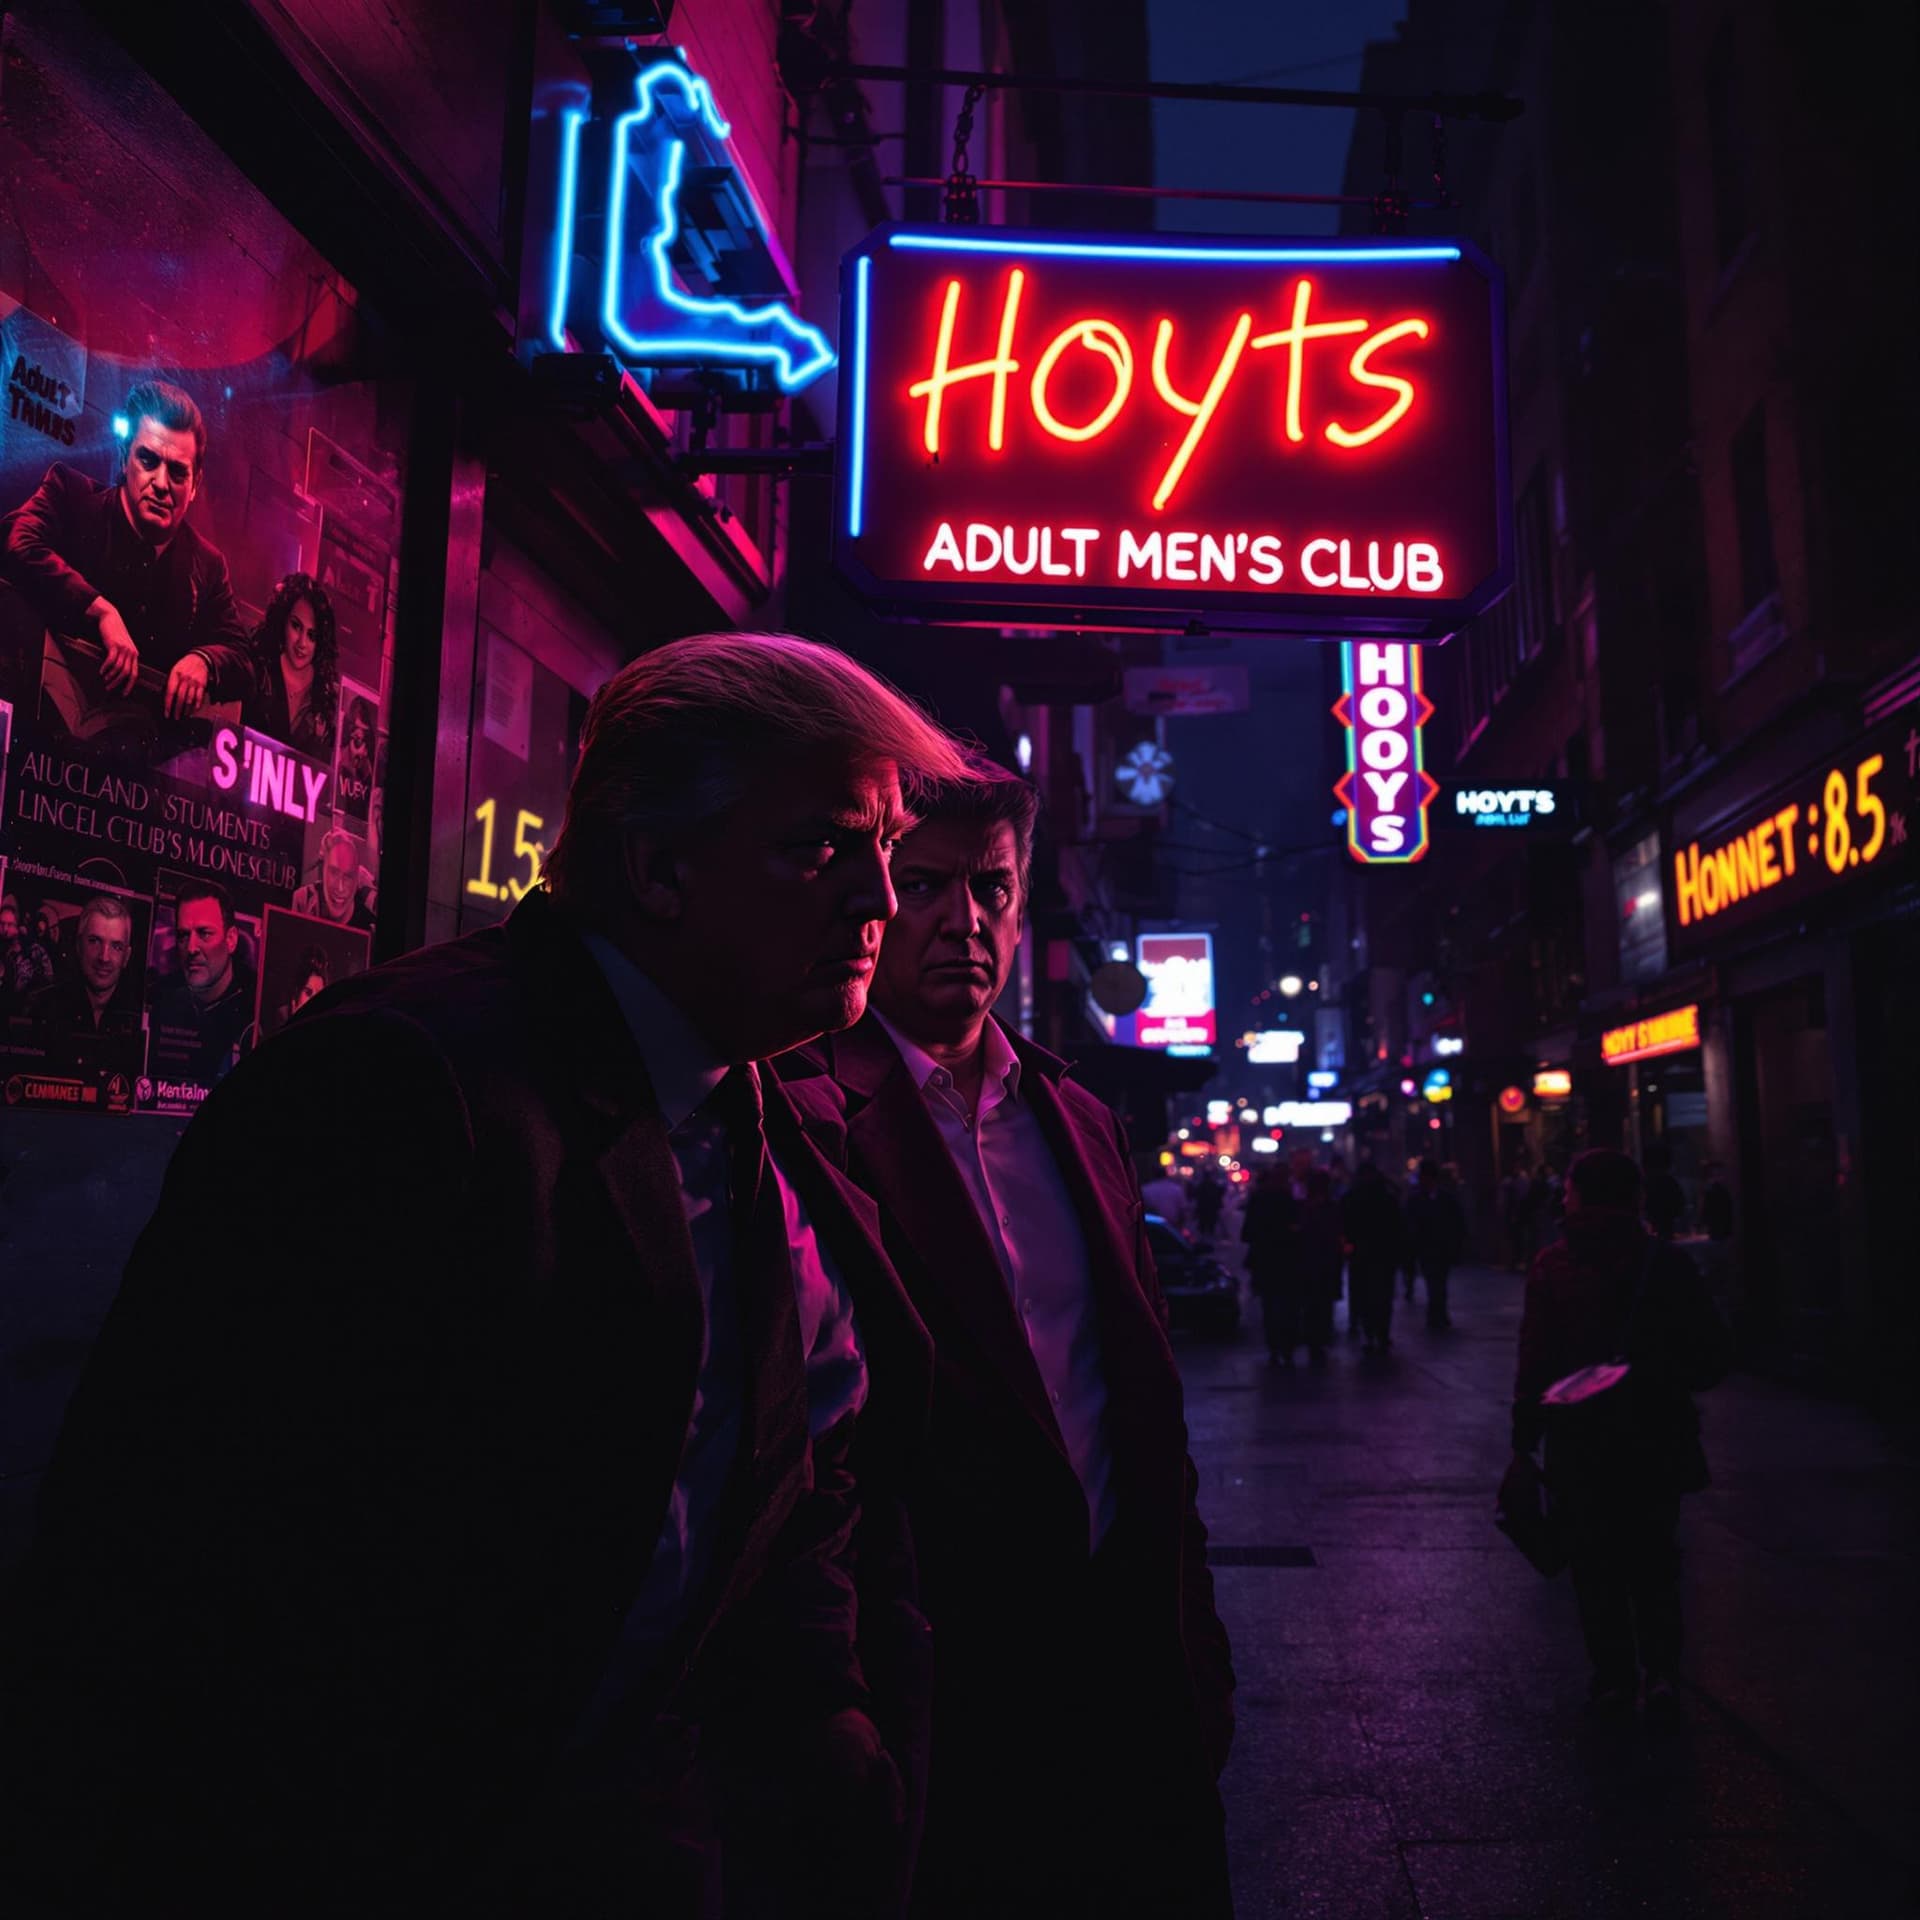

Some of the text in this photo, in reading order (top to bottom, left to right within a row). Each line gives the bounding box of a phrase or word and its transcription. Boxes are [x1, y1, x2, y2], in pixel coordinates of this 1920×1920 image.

[909, 268, 1431, 511] Hoyts
[923, 522, 1444, 592] ADULT MEN'S CLUB
[1358, 643, 1409, 853] HOOYS
[18, 788, 103, 839] LINCEL
[1675, 804, 1799, 926] HONNET
